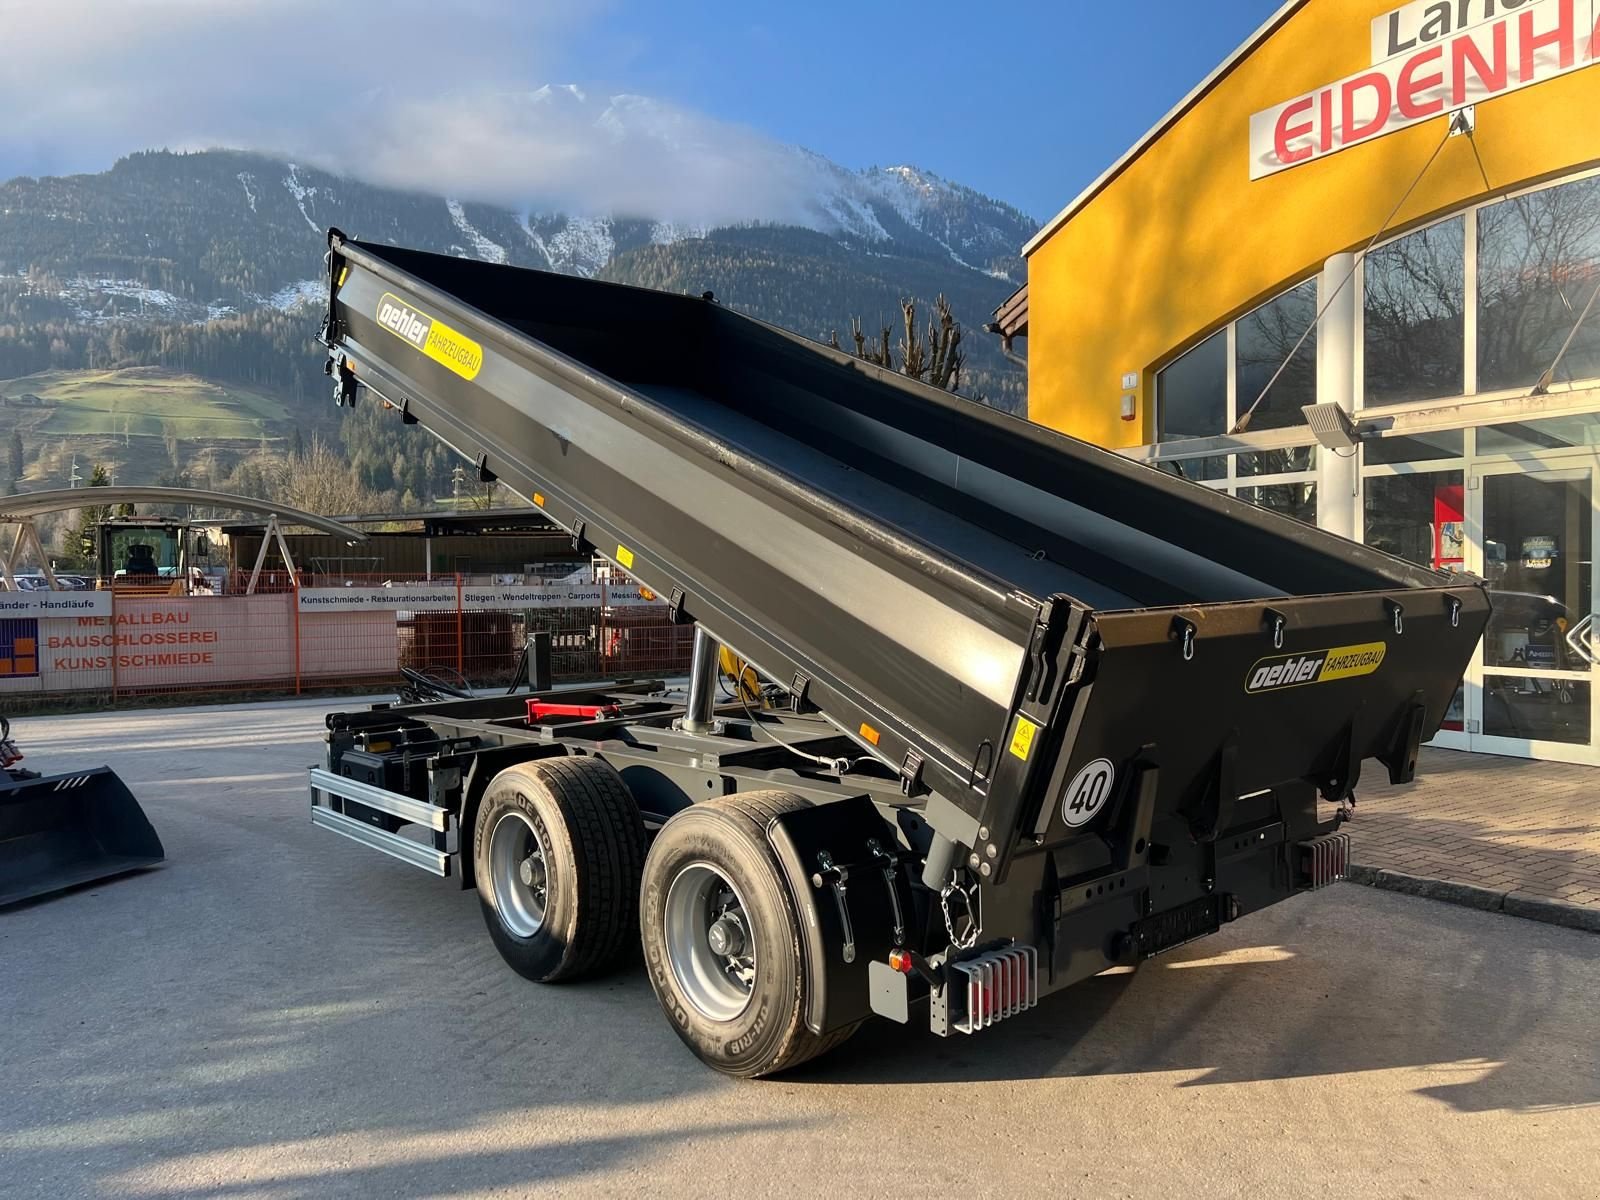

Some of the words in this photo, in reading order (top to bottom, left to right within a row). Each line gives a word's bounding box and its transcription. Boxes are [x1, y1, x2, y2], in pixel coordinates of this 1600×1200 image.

[380, 304, 428, 344] oehler
[427, 330, 481, 372] FAHRZEUGBAU
[40, 599, 94, 609] Handläufe
[301, 595, 364, 604] Kunstschmiede
[371, 594, 456, 603] Restaurationsarbeiten
[465, 594, 496, 603] Stiegen
[502, 593, 561, 602] Wendeltreppen
[568, 592, 600, 601] Carports
[48, 631, 218, 649] BAUSCHLOSSEREI
[55, 652, 214, 670] KUNSTSCHMIEDE
[1249, 656, 1324, 689] oehler
[1323, 650, 1384, 673] FAHRZEUGBAU
[1069, 770, 1108, 815] 40
